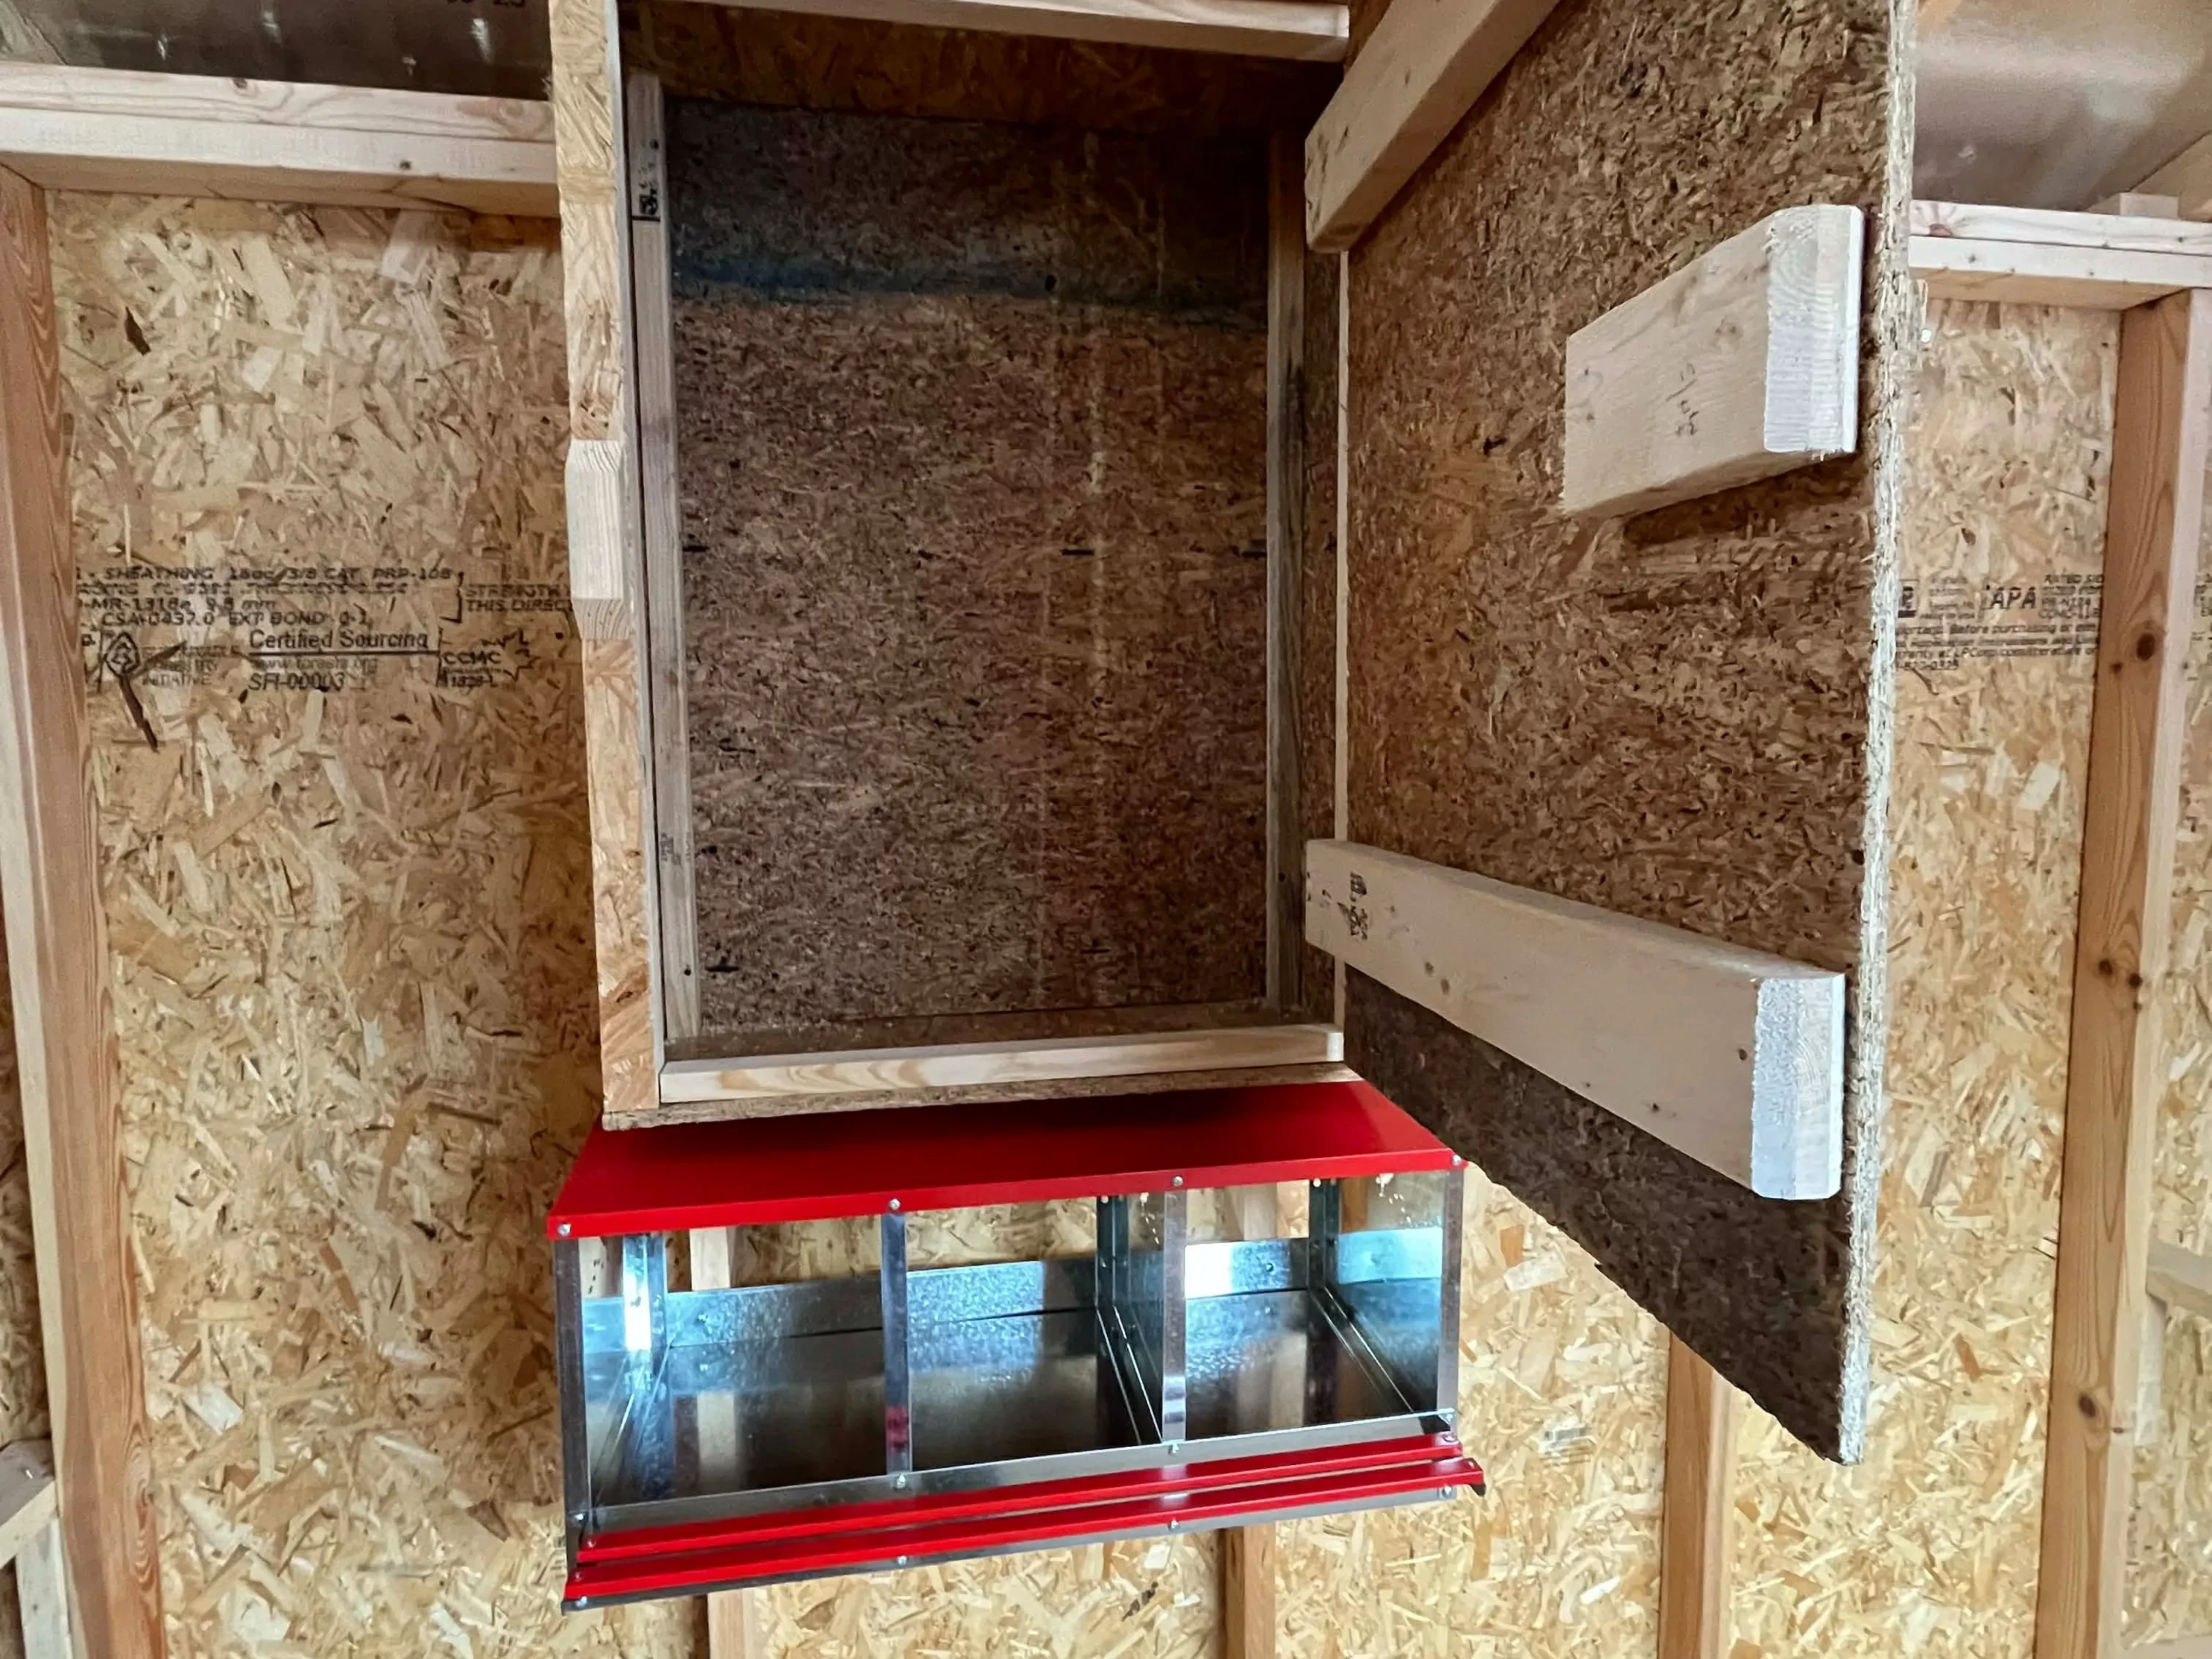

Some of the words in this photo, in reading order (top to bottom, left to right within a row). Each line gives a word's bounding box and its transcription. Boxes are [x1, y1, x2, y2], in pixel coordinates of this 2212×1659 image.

[104, 566, 214, 579] SHEATHING
[1989, 586, 2036, 609] APA
[466, 599, 505, 612] THIS
[270, 612, 326, 626] BOND
[249, 629, 334, 649] Certified
[339, 629, 429, 650] Sourcing
[442, 650, 503, 665] CCMC
